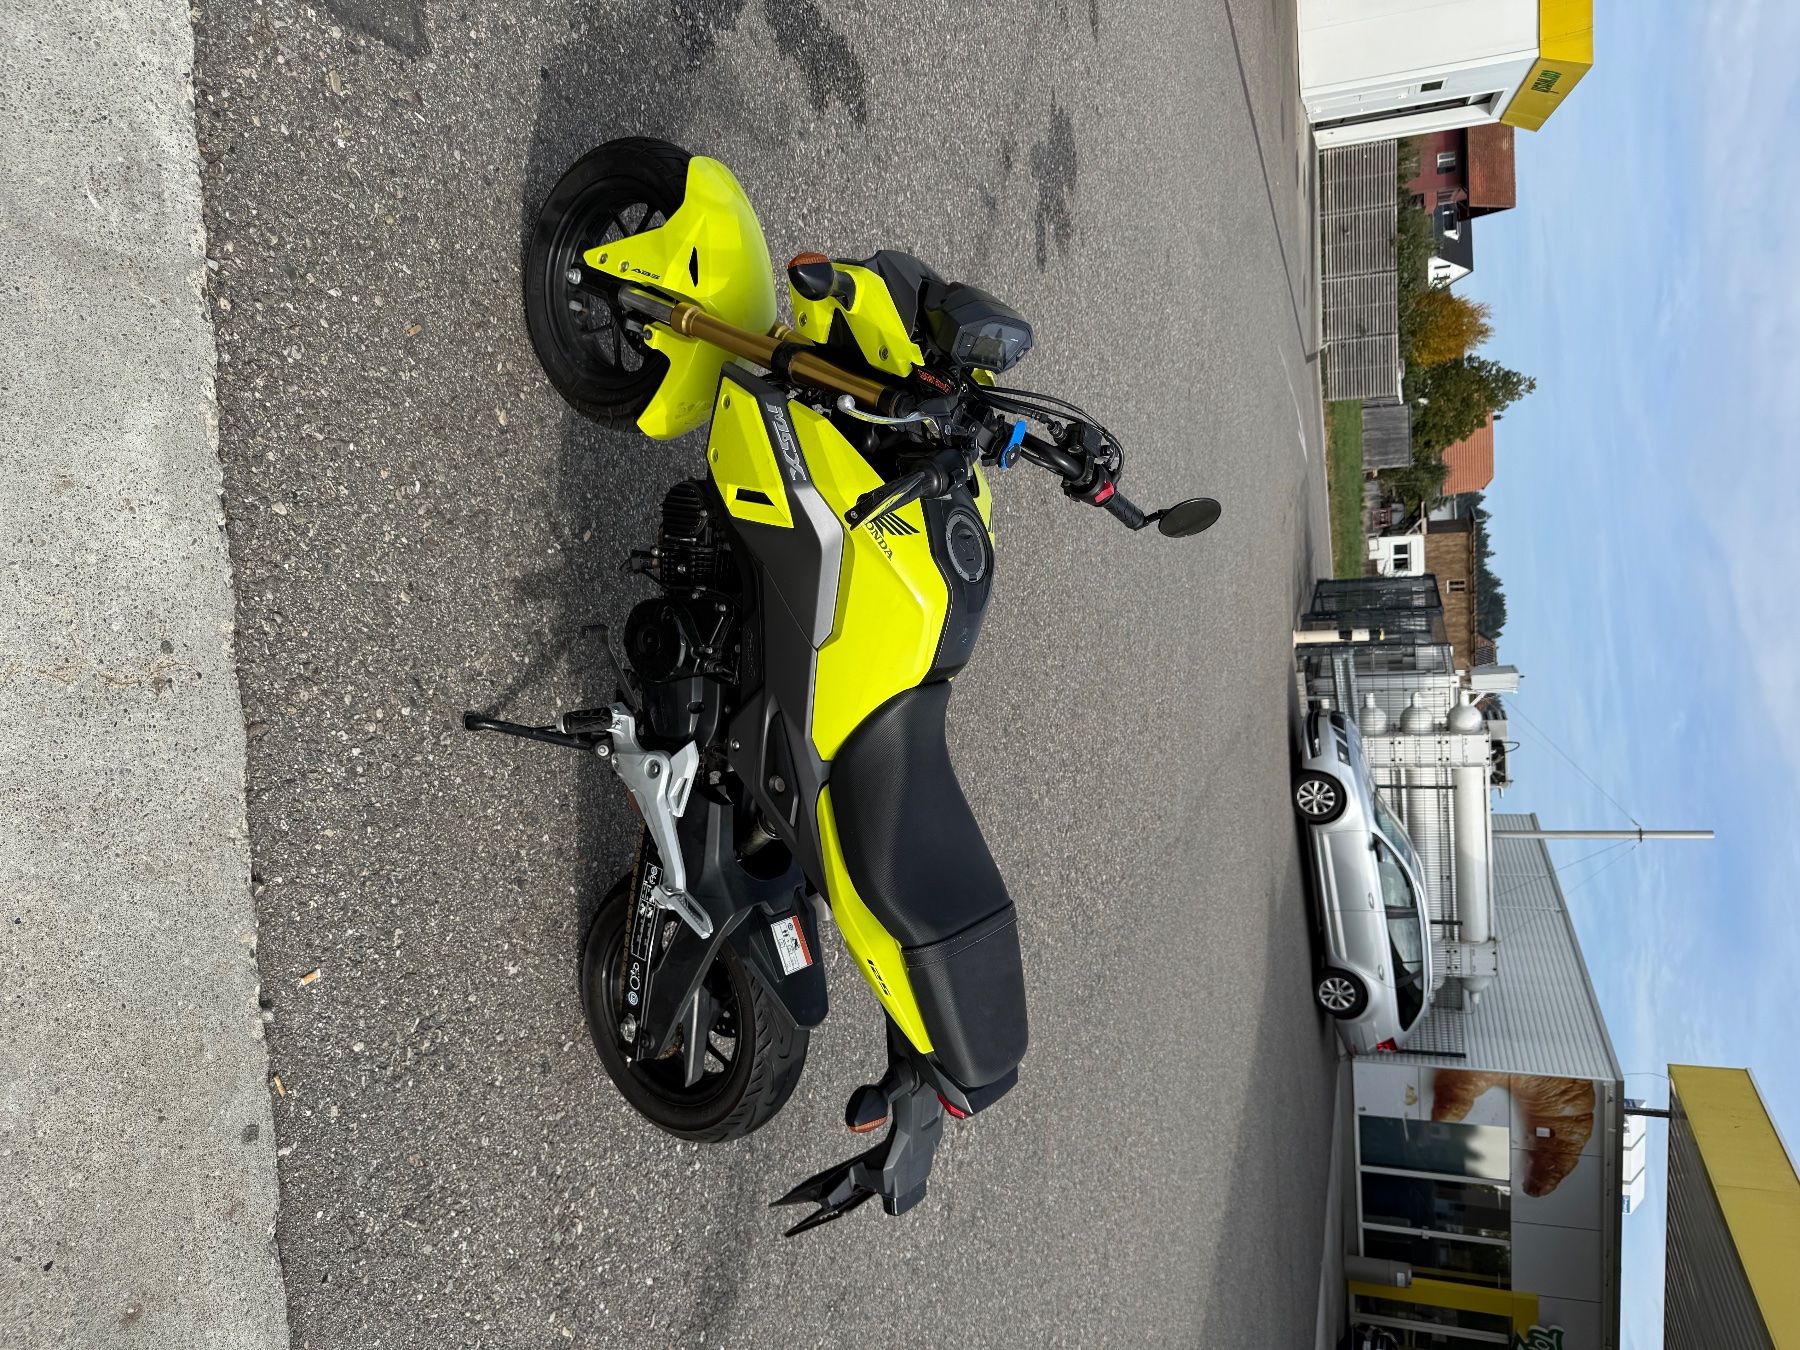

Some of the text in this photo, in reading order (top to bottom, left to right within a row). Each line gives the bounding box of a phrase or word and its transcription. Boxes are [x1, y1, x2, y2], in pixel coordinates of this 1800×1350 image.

[631, 269, 660, 279] ABS
[766, 402, 806, 480] MSX
[865, 521, 893, 561] ONDA
[867, 959, 891, 997] 125
